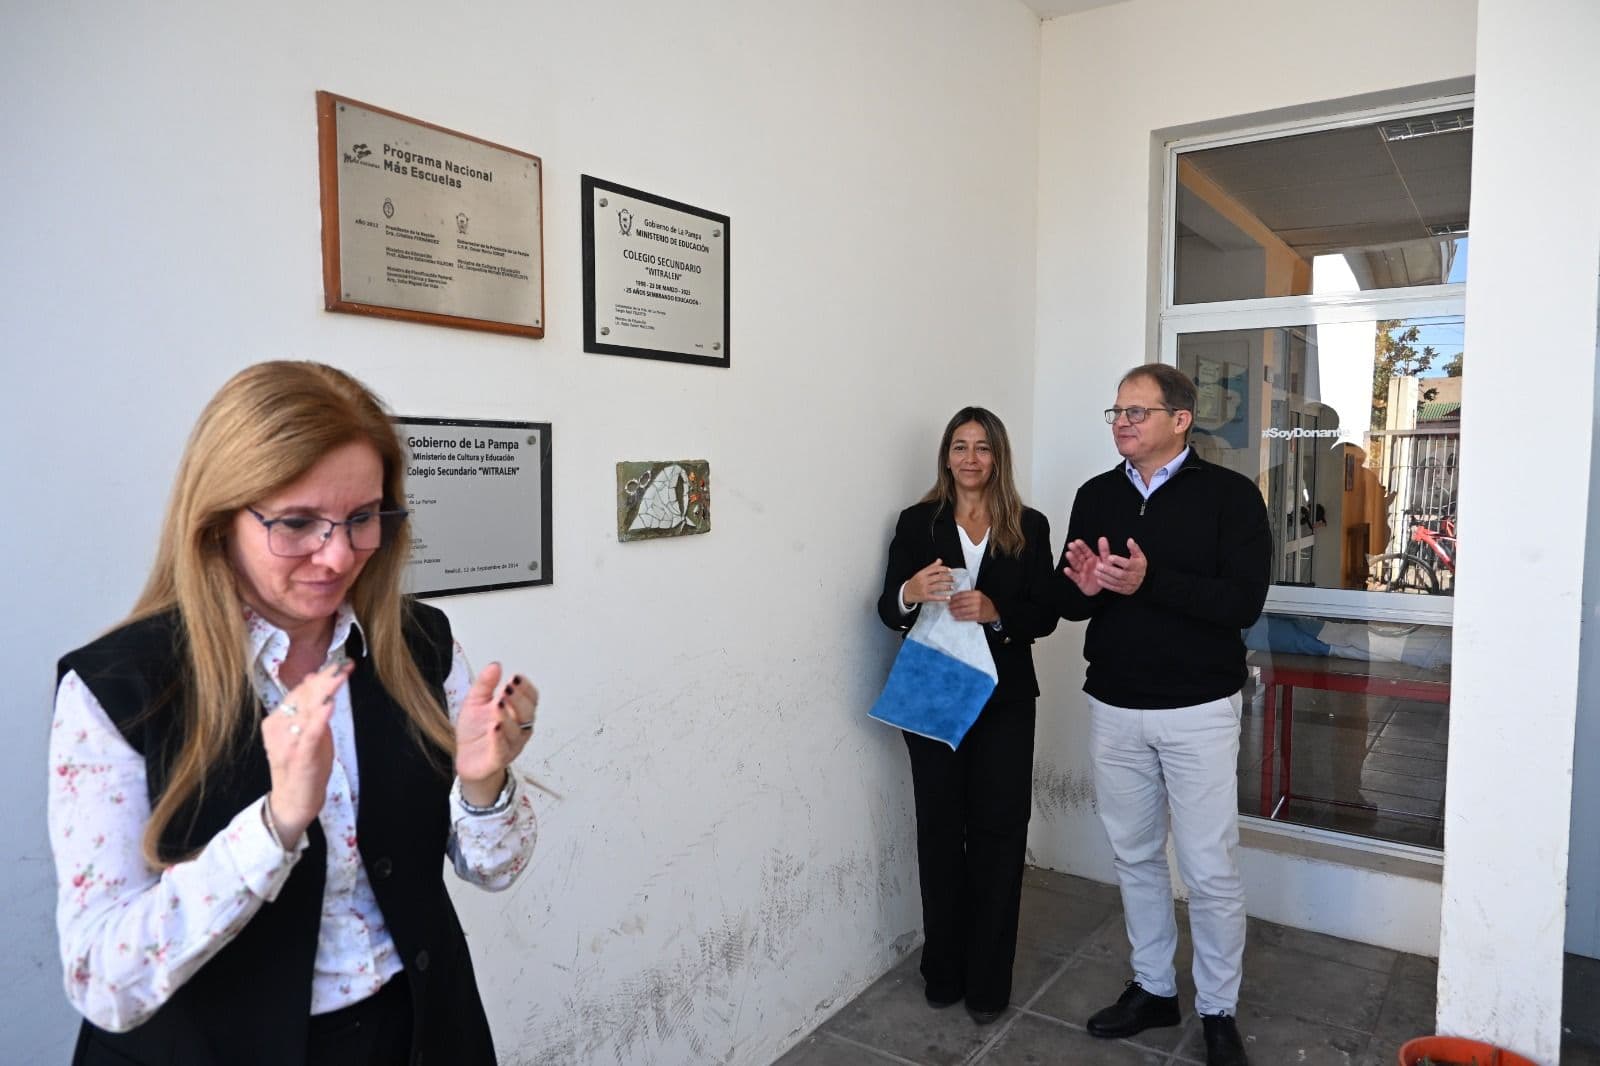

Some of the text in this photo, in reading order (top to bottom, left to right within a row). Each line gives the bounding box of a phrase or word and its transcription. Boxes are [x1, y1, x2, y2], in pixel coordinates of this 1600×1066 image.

[383, 143, 492, 182] Programa Nacional
[384, 159, 462, 188] Más Escuelas
[644, 219, 670, 232] Gobierno
[670, 225, 677, 233] de
[685, 230, 702, 240] Pampa
[636, 229, 709, 253] MINISTERIO DE EDUCACIÓN
[623, 249, 702, 274] COLEGIO SECUNDARIO
[645, 267, 682, 280] "WITRALEN"
[633, 288, 646, 296] AÑOS
[662, 285, 678, 293] MARZO
[408, 436, 519, 451] Gobierno de La Pampa
[413, 452, 446, 461] Ministerio
[407, 467, 520, 478] Colegio Secundario "WITRALEN"
